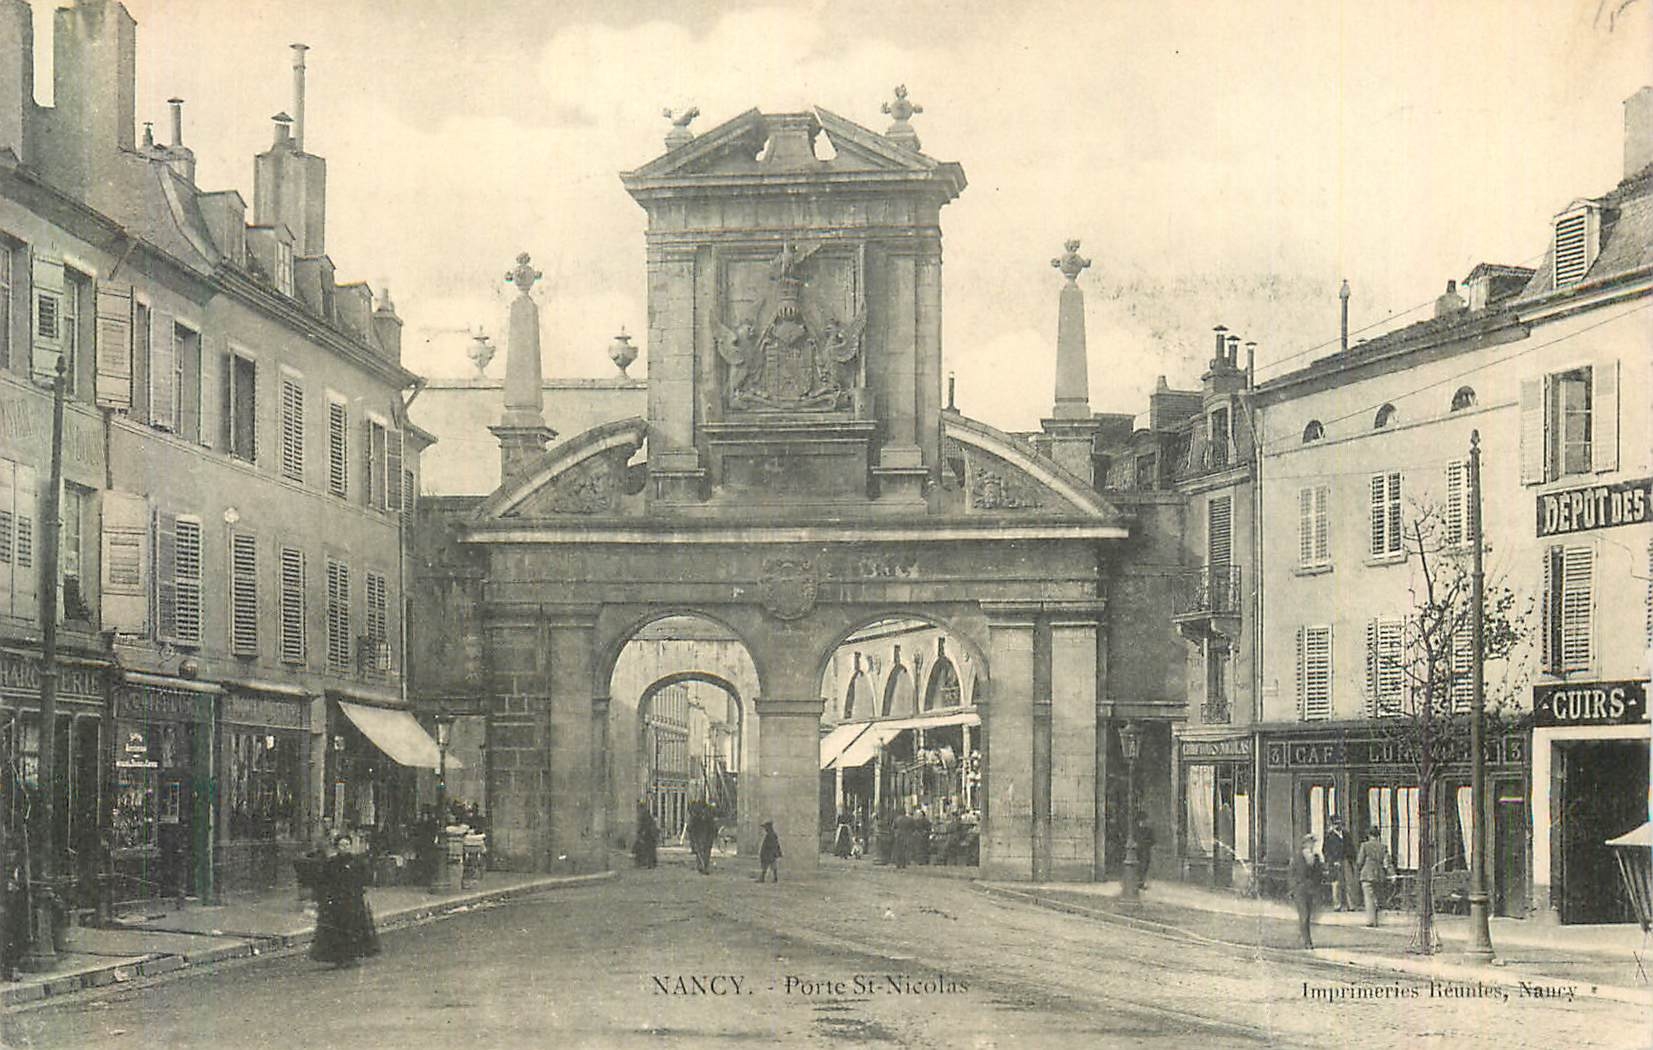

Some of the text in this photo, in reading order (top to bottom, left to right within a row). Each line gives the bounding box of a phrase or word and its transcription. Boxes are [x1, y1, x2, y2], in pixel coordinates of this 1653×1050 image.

[1611, 488, 1645, 523] DES
[1552, 687, 1625, 720] CUIRS
[1271, 747, 1281, 764] 3
[1511, 741, 1521, 760] 3
